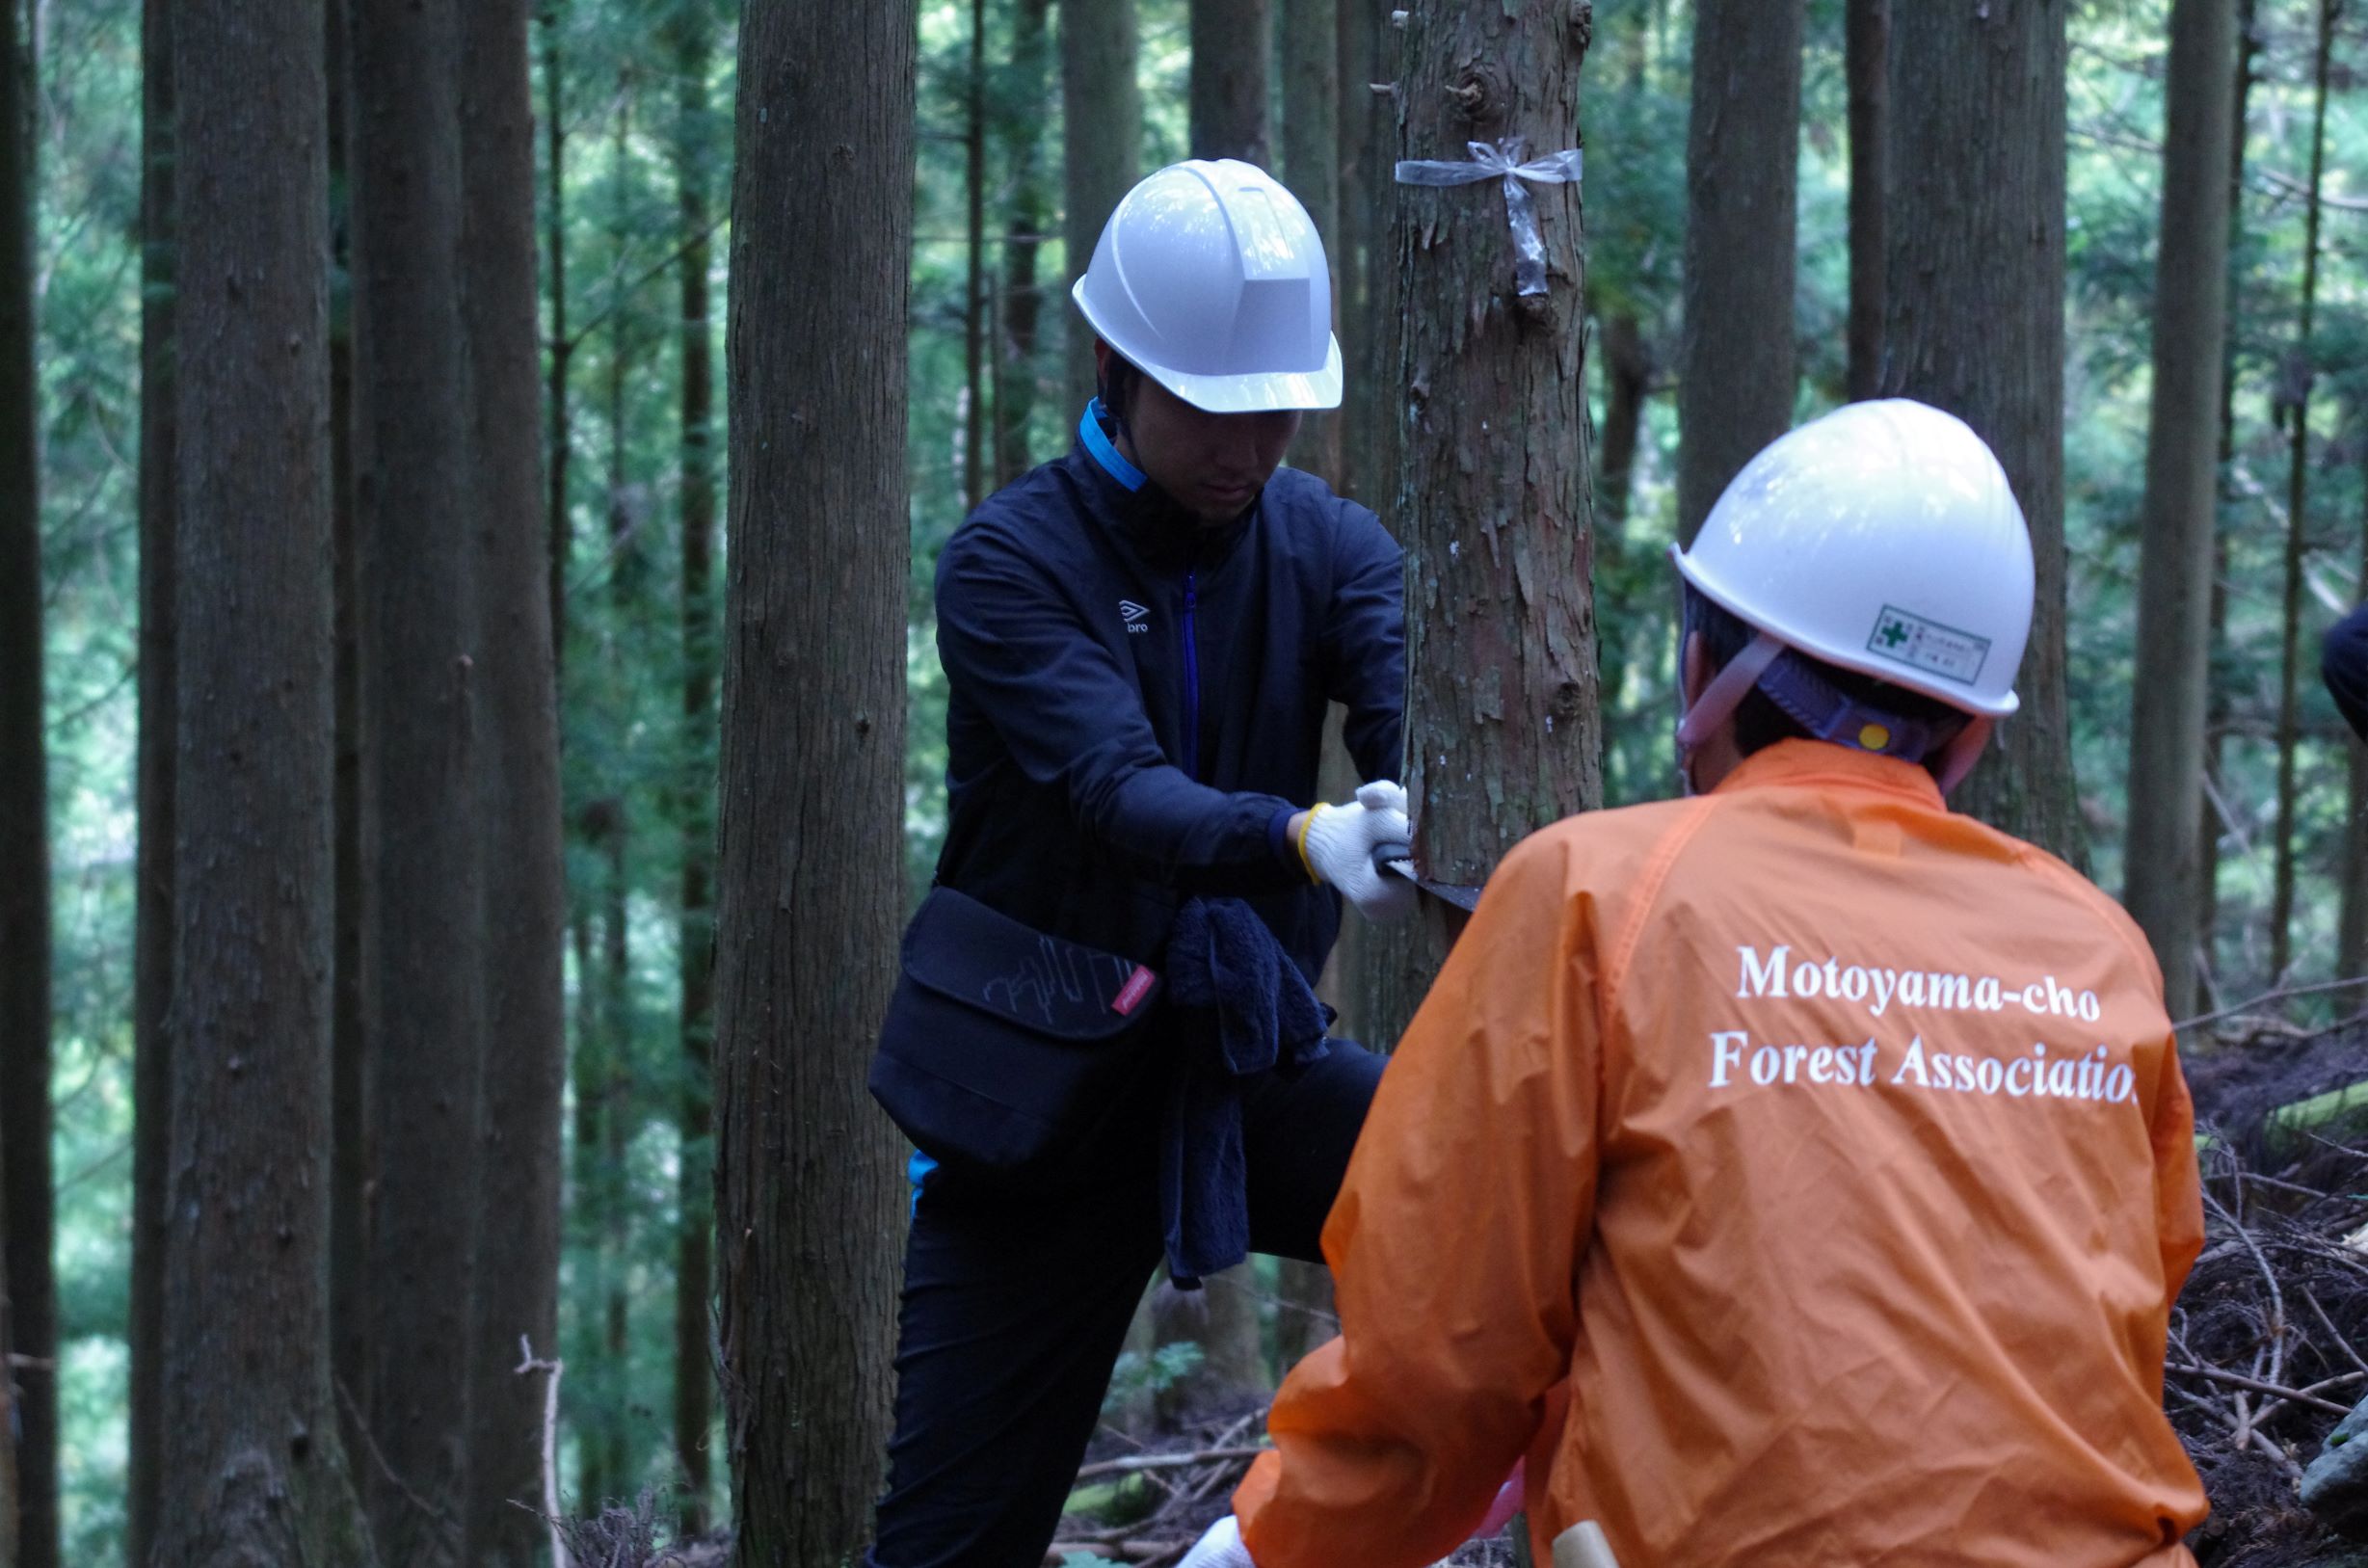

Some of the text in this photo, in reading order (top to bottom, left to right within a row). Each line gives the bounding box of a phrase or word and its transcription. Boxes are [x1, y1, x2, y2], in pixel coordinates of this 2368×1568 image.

[1127, 622, 1148, 633] bro
[1737, 945, 2101, 1023] Motoyama-cho
[1709, 1030, 2138, 1104] Forest Associatio
